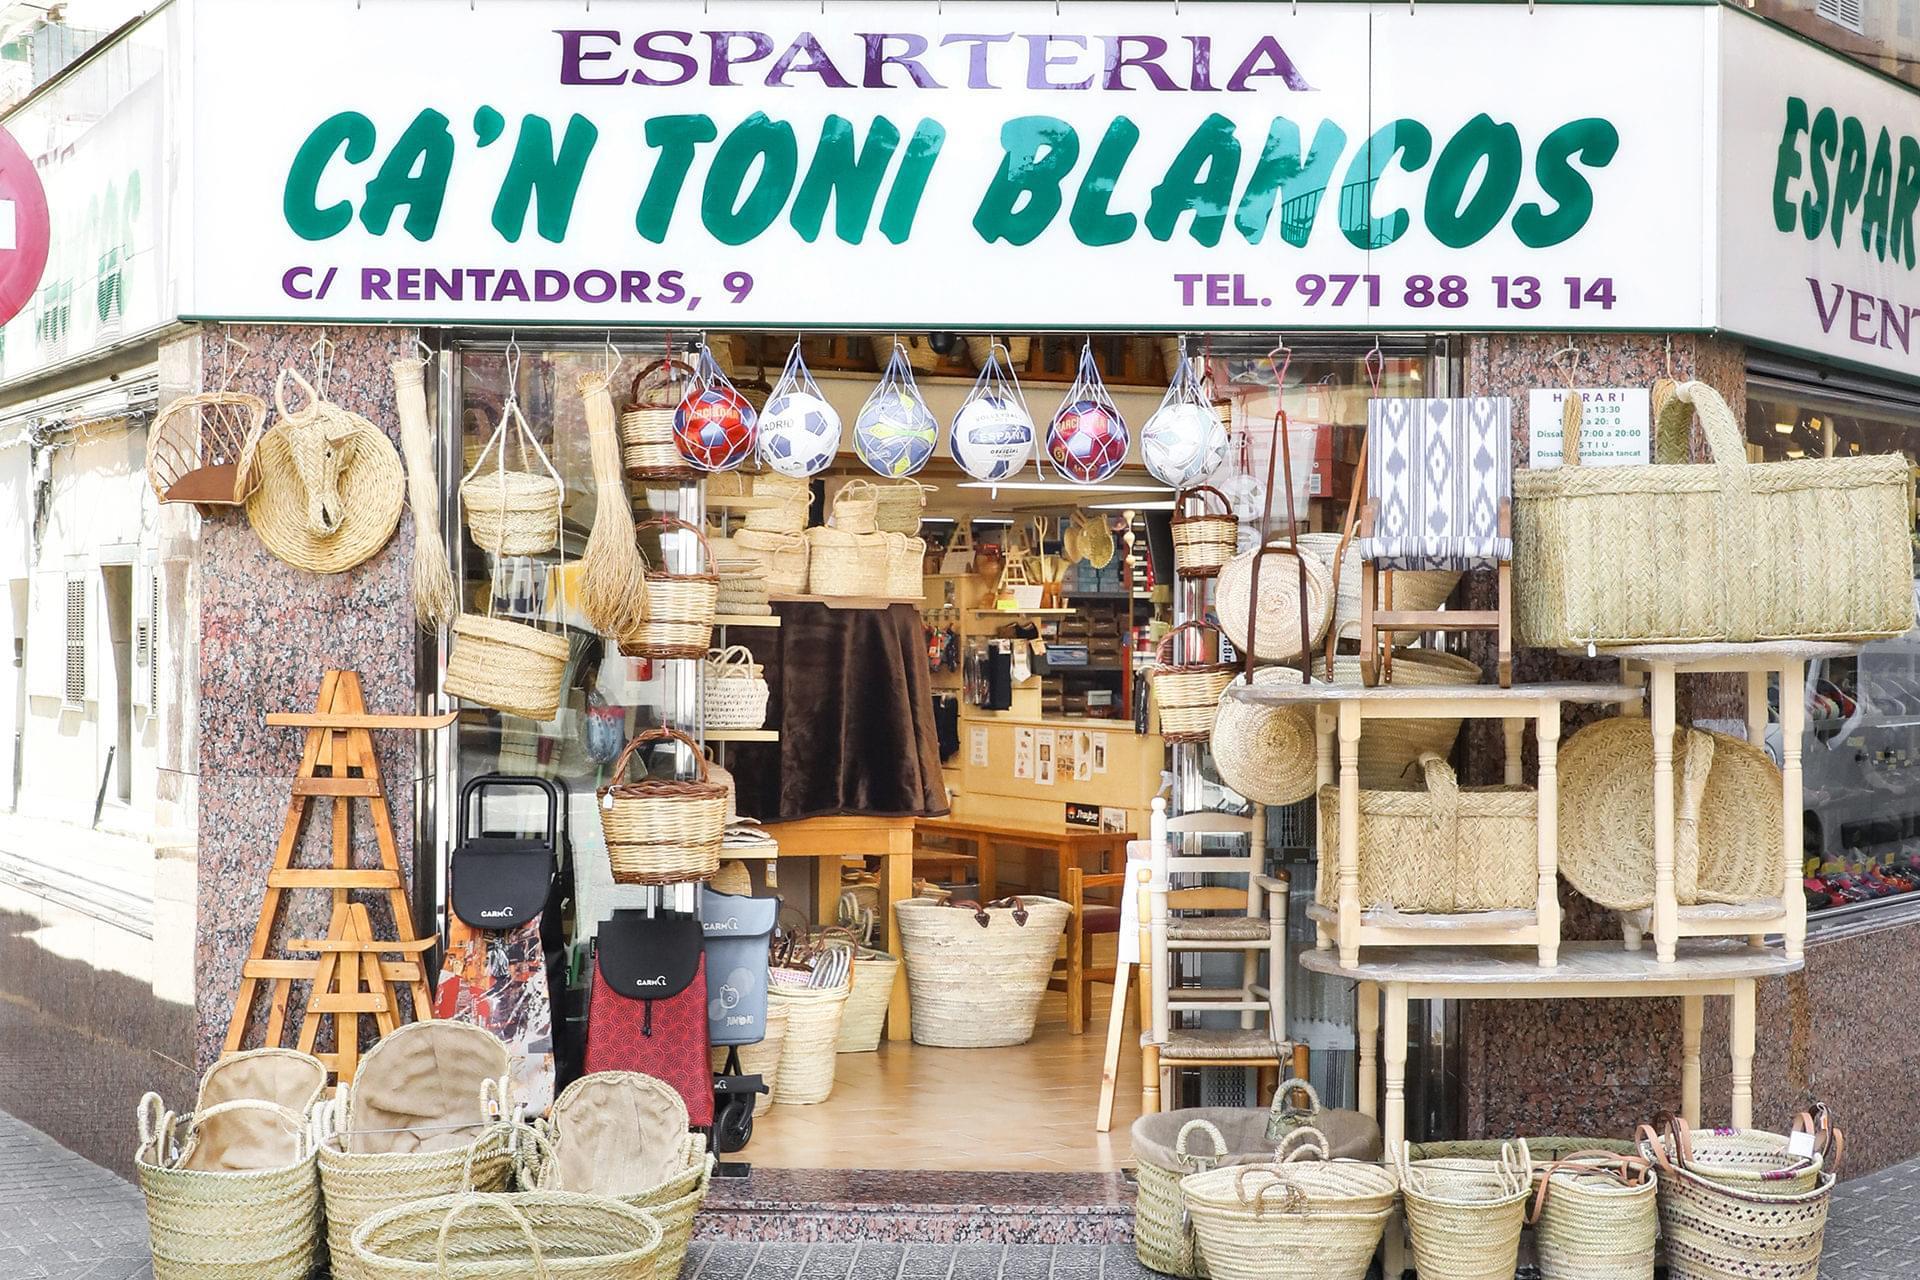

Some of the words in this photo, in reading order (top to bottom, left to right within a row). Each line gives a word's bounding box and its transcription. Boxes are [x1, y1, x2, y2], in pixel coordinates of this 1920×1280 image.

[551, 30, 1321, 92] ESPARTERIA
[635, 110, 947, 246] TONI
[972, 112, 1620, 250] BLANCOS
[1773, 96, 1920, 271] ESPAR
[281, 266, 338, 300] C/
[361, 267, 700, 311] RENTADORS,
[722, 271, 754, 304] 9
[1174, 273, 1272, 306] TEL.
[1295, 273, 1381, 308] 971
[1403, 274, 1470, 308] 88
[1491, 275, 1543, 309] 13
[1564, 276, 1617, 310] 14
[1553, 392, 1625, 402] HRARI
[1595, 417, 1620, 425] 20:0
[1615, 429, 1641, 437] 20:00
